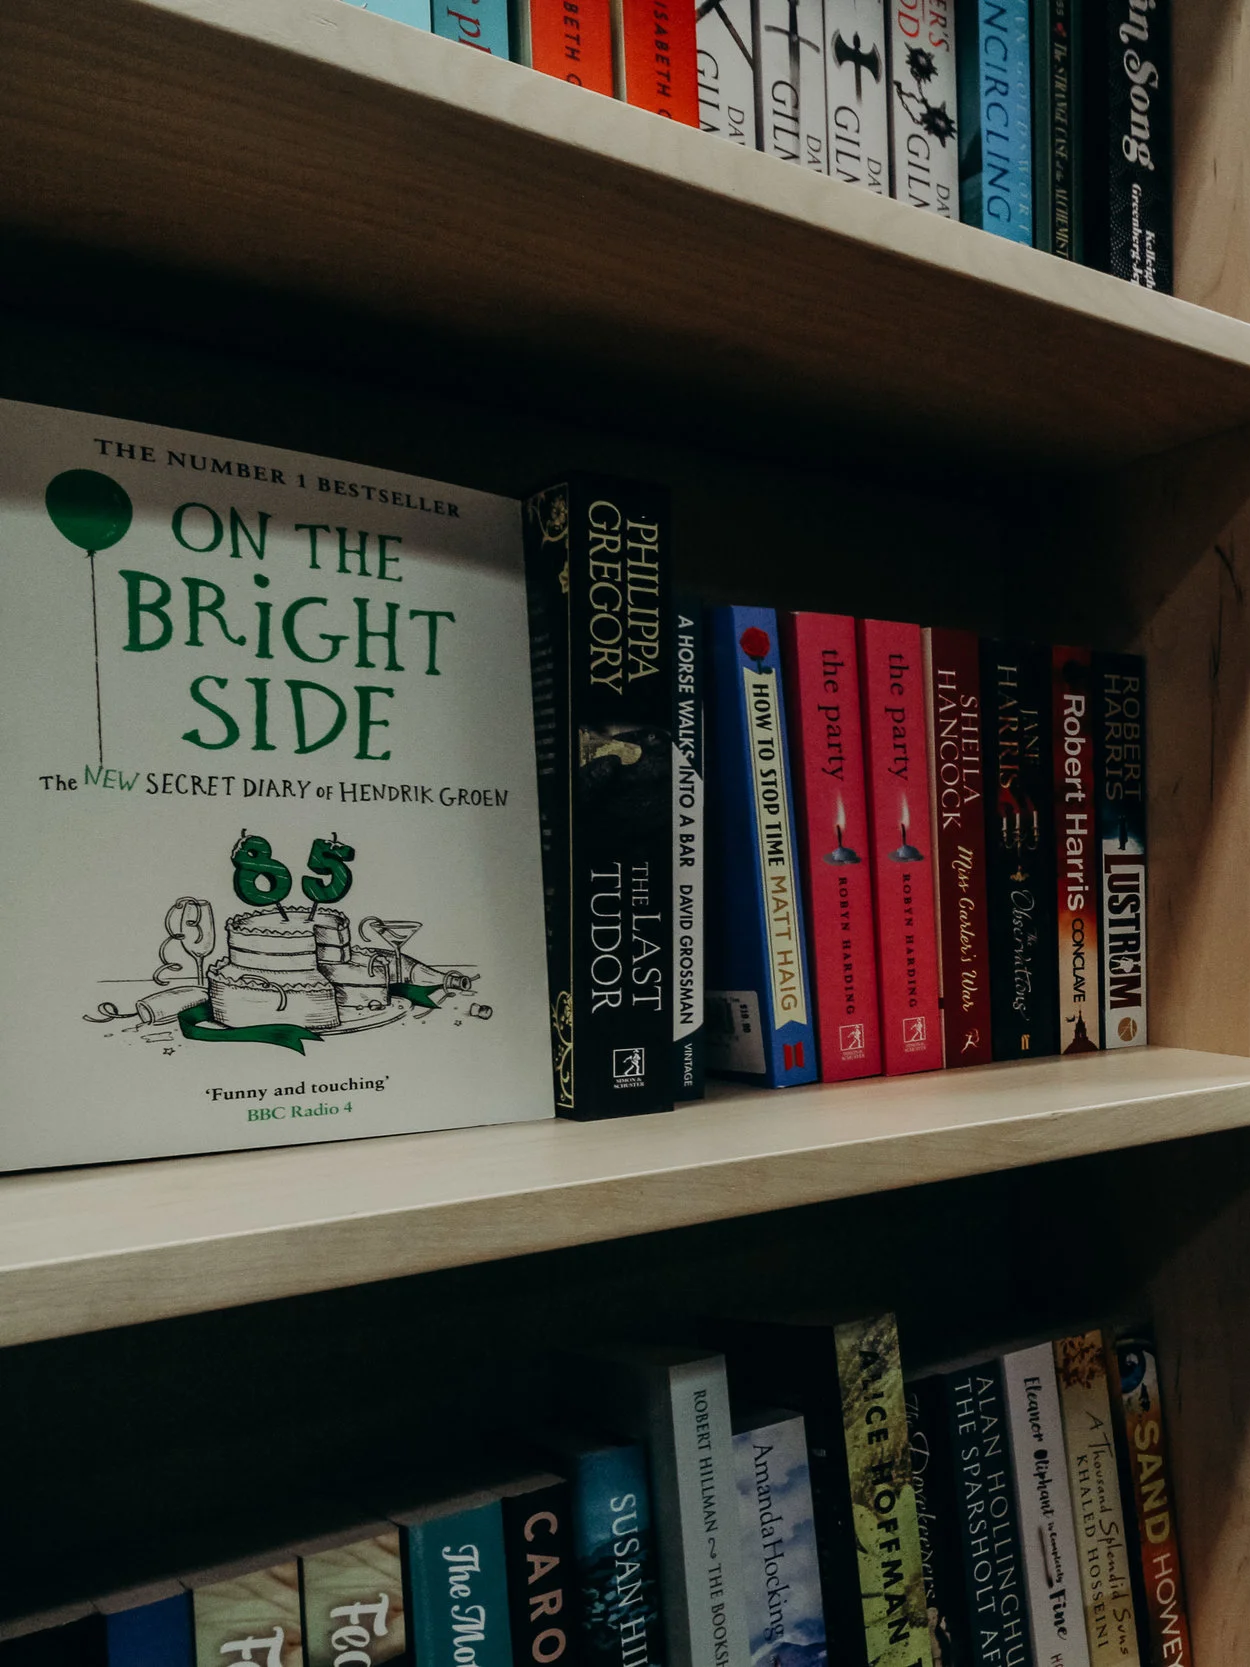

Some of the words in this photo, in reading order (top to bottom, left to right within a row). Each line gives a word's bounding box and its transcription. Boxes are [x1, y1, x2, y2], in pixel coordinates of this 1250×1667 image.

[1121, 48, 1160, 172] Song
[94, 438, 157, 463] THE
[166, 448, 287, 486] NUMBER
[297, 472, 307, 489] 1
[317, 477, 461, 518] BESTSELLER
[171, 502, 273, 561] ON
[294, 522, 404, 583] THE
[587, 499, 624, 697] GREGORY
[626, 517, 660, 684] PHILIPPA
[677, 614, 695, 629] A
[677, 634, 696, 695] HORSE
[821, 649, 845, 693] the
[887, 652, 910, 696] the
[181, 674, 395, 762] SIDE
[678, 698, 696, 760] WALKS
[752, 683, 773, 731] HOW
[817, 704, 846, 782] party
[884, 705, 910, 782] party
[996, 663, 1020, 790] HARRIS
[1103, 673, 1124, 801] HARRIS
[1120, 675, 1142, 802] ROBERT
[39, 775, 78, 792] The
[84, 764, 140, 792] NEW
[145, 773, 236, 797] SECRET
[243, 778, 312, 800] DIARY
[339, 781, 435, 805] HENDRIK
[438, 787, 509, 808] GROEN
[757, 737, 776, 761] TO
[936, 668, 962, 831] HANCOCK
[959, 693, 982, 804] SHEILA
[1062, 693, 1087, 803] Robert
[679, 765, 696, 808] INTO
[679, 813, 695, 828] A
[760, 767, 780, 815] STOP
[679, 833, 696, 868] BAR
[765, 821, 786, 867] TIME
[1065, 813, 1090, 912] Harris
[631, 861, 649, 907] THE
[679, 884, 694, 931] DAVID
[770, 875, 793, 942] MATT
[838, 877, 850, 931] ROBYN
[902, 873, 914, 927] ROBYN
[590, 861, 624, 1015] TUDOR
[631, 911, 663, 1013] LAST
[1071, 918, 1086, 1003] CONCLAVE
[1104, 853, 1143, 1011] LUSTRUM
[679, 936, 694, 1025] GROSSMAN
[776, 949, 799, 1012] HAIG
[841, 939, 856, 1016] HARDING
[904, 934, 918, 1008] HARDING
[959, 968, 978, 1013] War
[274, 1082, 307, 1097] and
[682, 1042, 694, 1087] VINTAGE
[247, 1106, 287, 1123] BBC
[291, 1102, 340, 1119] Radio
[344, 1100, 353, 1114] 4
[692, 1388, 713, 1452] ROBERT
[857, 1349, 890, 1446] ALICE
[954, 1377, 977, 1436] THE
[975, 1375, 1003, 1460] ALAN
[1023, 1375, 1043, 1443] Eleanor
[1085, 1410, 1105, 1431] A
[698, 1458, 720, 1534] HILLMAN
[752, 1443, 784, 1541] Amanda
[1032, 1449, 1052, 1517] Oliphant
[1088, 1431, 1114, 1513] Thousand
[1134, 1419, 1172, 1545] SAND
[609, 1492, 645, 1609] SUSAN
[869, 1460, 911, 1647] HOFFMAN
[960, 1445, 997, 1614] SPARSHOLT
[1076, 1454, 1096, 1538] KHALED
[1086, 1547, 1109, 1649] HOSSEINI
[1099, 1518, 1127, 1601] Splendid
[441, 1543, 482, 1600] The
[523, 1510, 568, 1664] CARO
[707, 1562, 724, 1599] THE
[762, 1536, 790, 1642] Hocking
[1152, 1551, 1188, 1667] HOWEY
[1049, 1587, 1068, 1641] Fine
[1111, 1606, 1133, 1656] Suns
